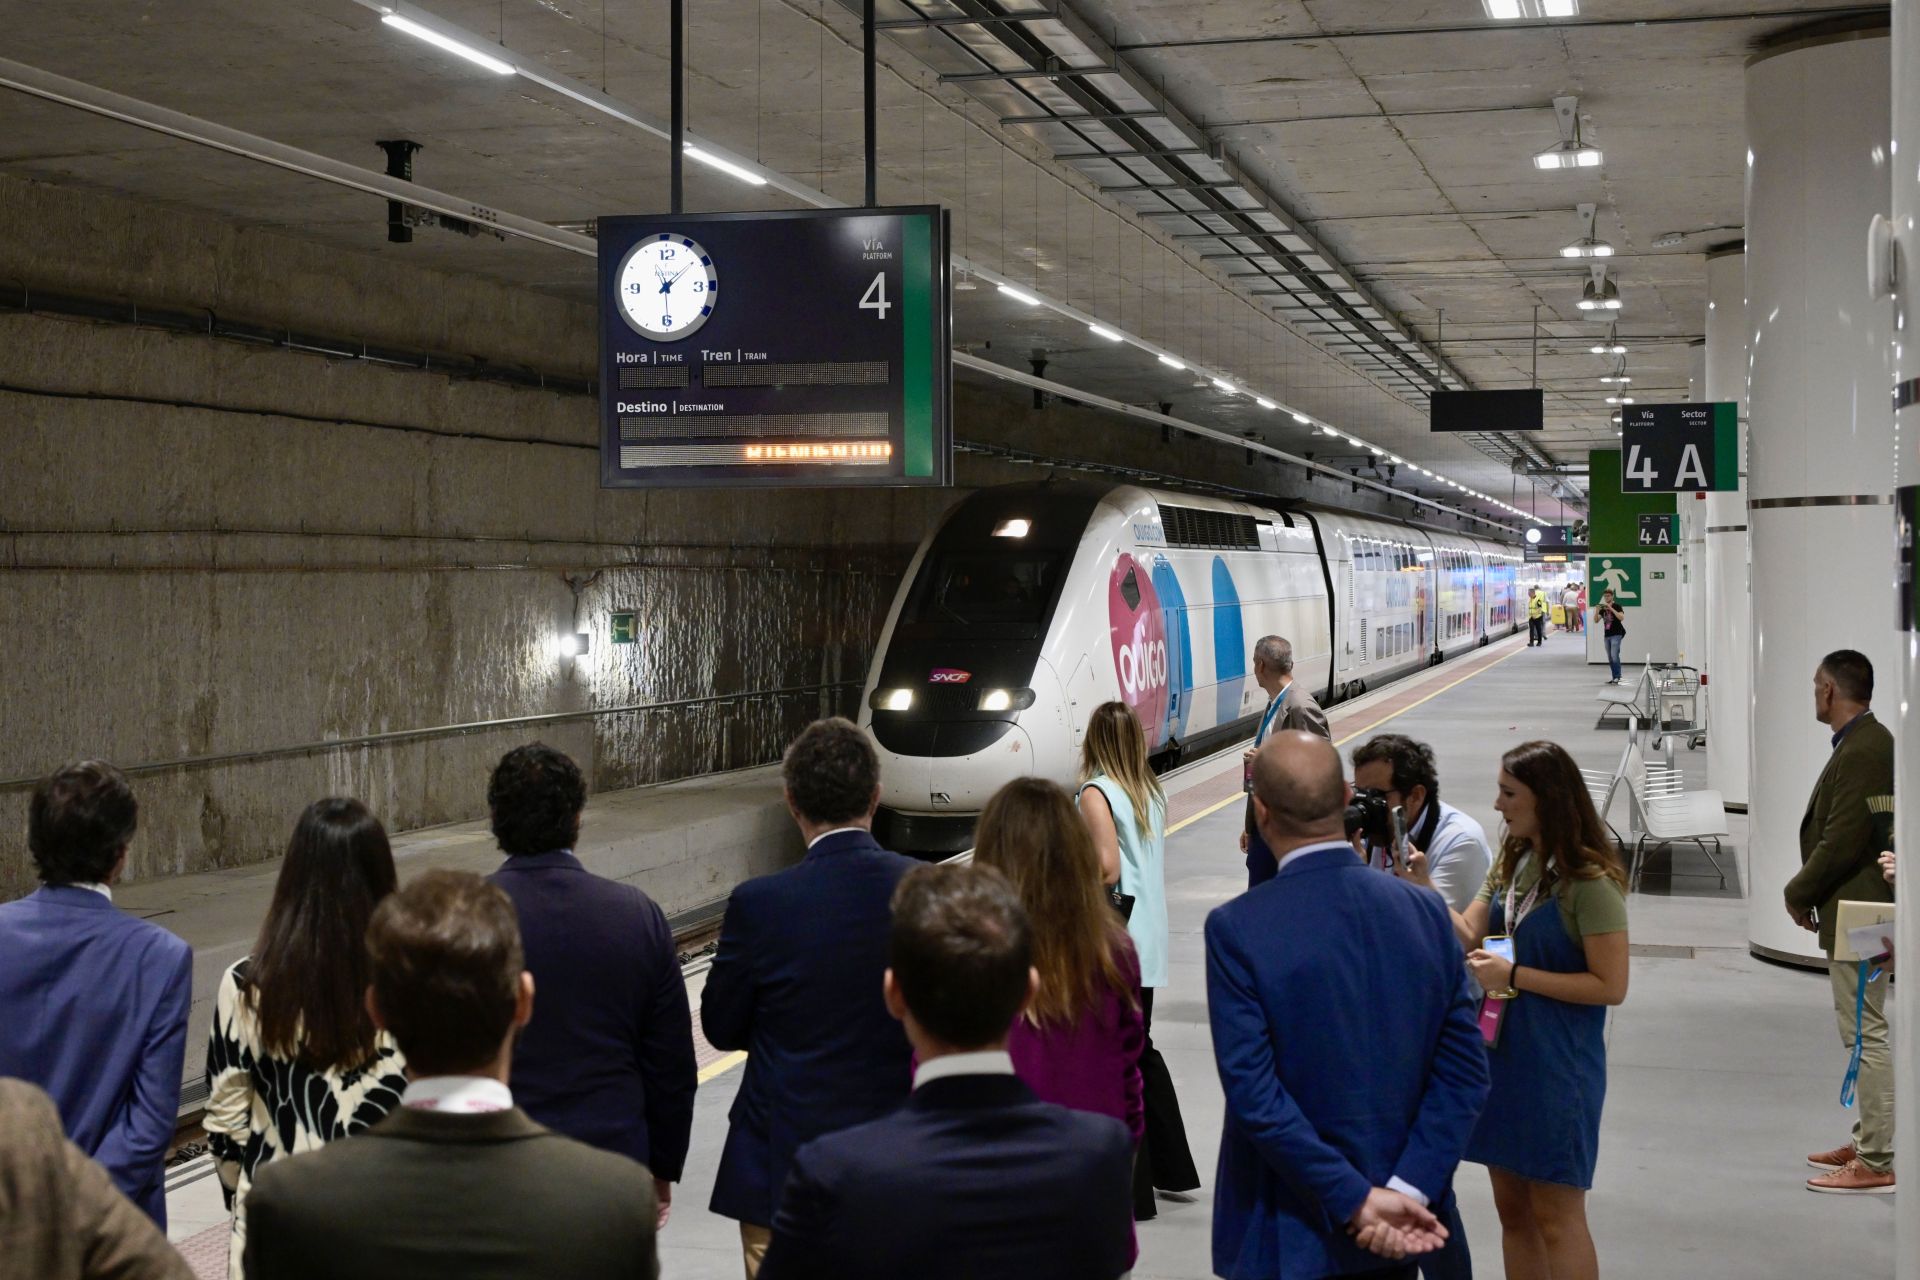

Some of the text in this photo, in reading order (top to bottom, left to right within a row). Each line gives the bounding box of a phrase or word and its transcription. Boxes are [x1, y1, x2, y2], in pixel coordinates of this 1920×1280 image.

[659, 249, 675, 261] 12
[863, 252, 893, 260] PLATFORM
[630, 283, 641, 294] 9
[693, 281, 704, 293] 3
[858, 271, 892, 320] 4
[662, 314, 673, 327] 6
[616, 352, 683, 363] Hora TIME
[701, 350, 768, 361] Tren TRAIN
[617, 401, 724, 413] Destino DESTINATION
[1641, 410, 1654, 419] Vía
[1681, 410, 1707, 418] Sector
[1626, 444, 1708, 488] 4 A
[1640, 528, 1669, 545] 4 A
[930, 673, 969, 682] SNCF
